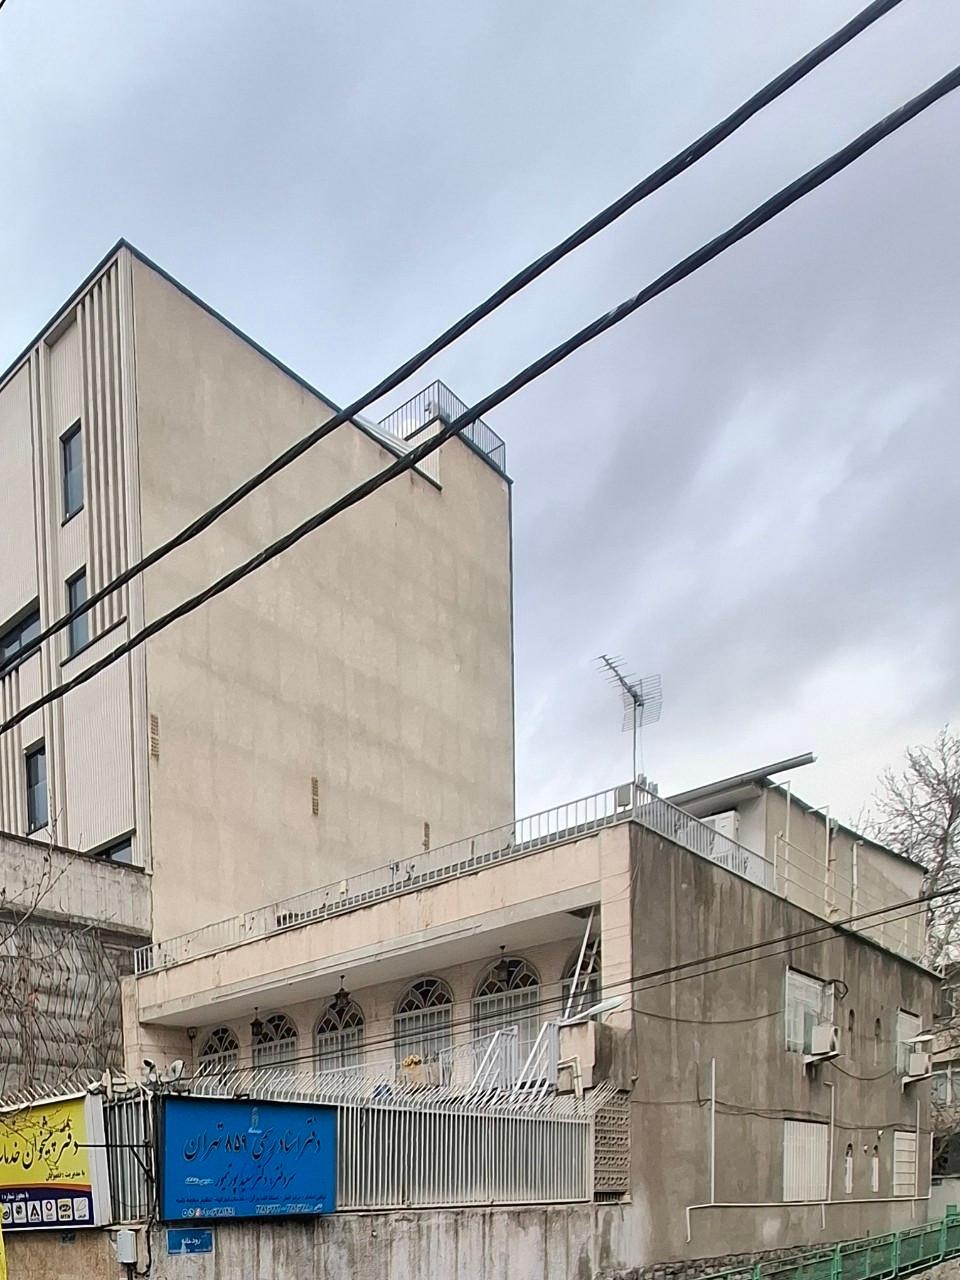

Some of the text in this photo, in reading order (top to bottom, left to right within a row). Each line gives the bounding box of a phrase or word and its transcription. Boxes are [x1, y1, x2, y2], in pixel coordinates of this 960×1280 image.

[22, 1116, 56, 1171] پیشخوان
[54, 1120, 78, 1165] دفتر
[183, 1116, 321, 1162] دفتر اسناد رسمی ۸۵۹ تهران
